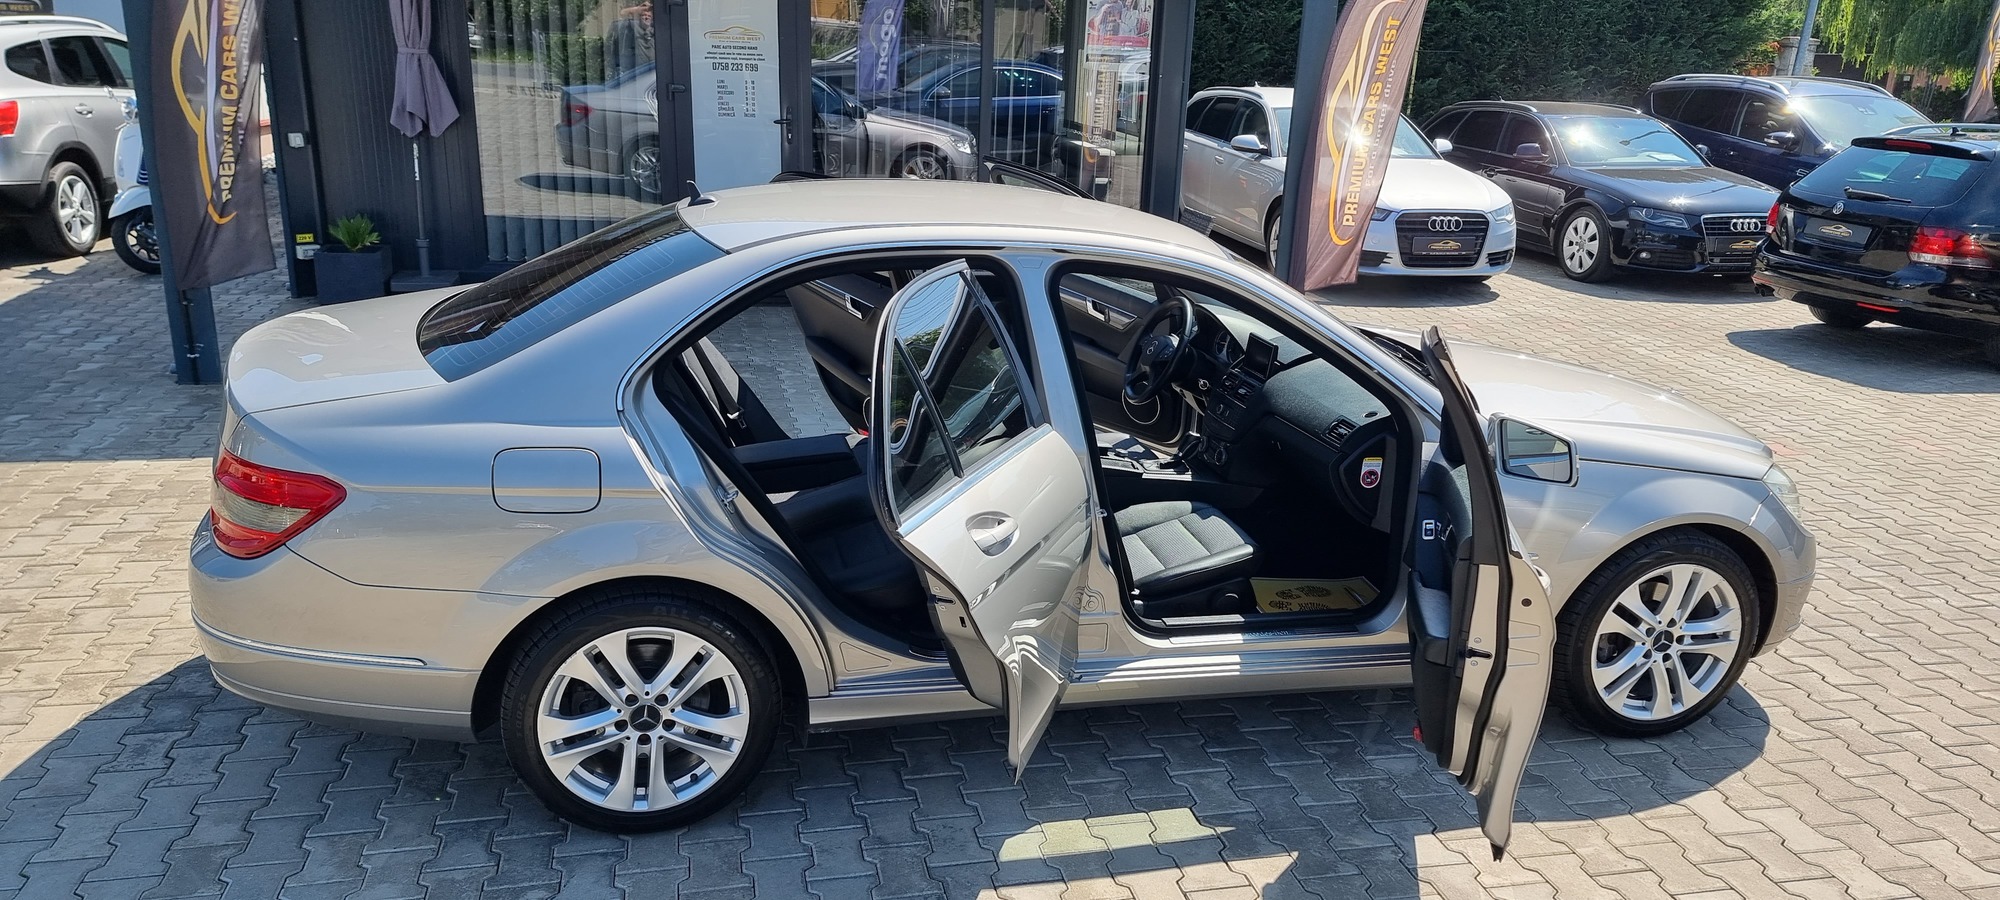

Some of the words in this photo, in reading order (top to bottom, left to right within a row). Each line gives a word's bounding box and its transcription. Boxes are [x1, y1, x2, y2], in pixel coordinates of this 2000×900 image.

[220, 35, 239, 100] CARS
[712, 62, 730, 71] 0758
[730, 63, 743, 72] 233
[744, 63, 759, 72] 699
[1343, 138, 1369, 227] PREMIUM
[1363, 81, 1383, 136] CARS
[1375, 15, 1401, 75] WEST
[1365, 165, 1375, 187] For
[1373, 103, 1388, 147] better
[1384, 60, 1397, 98] drive
